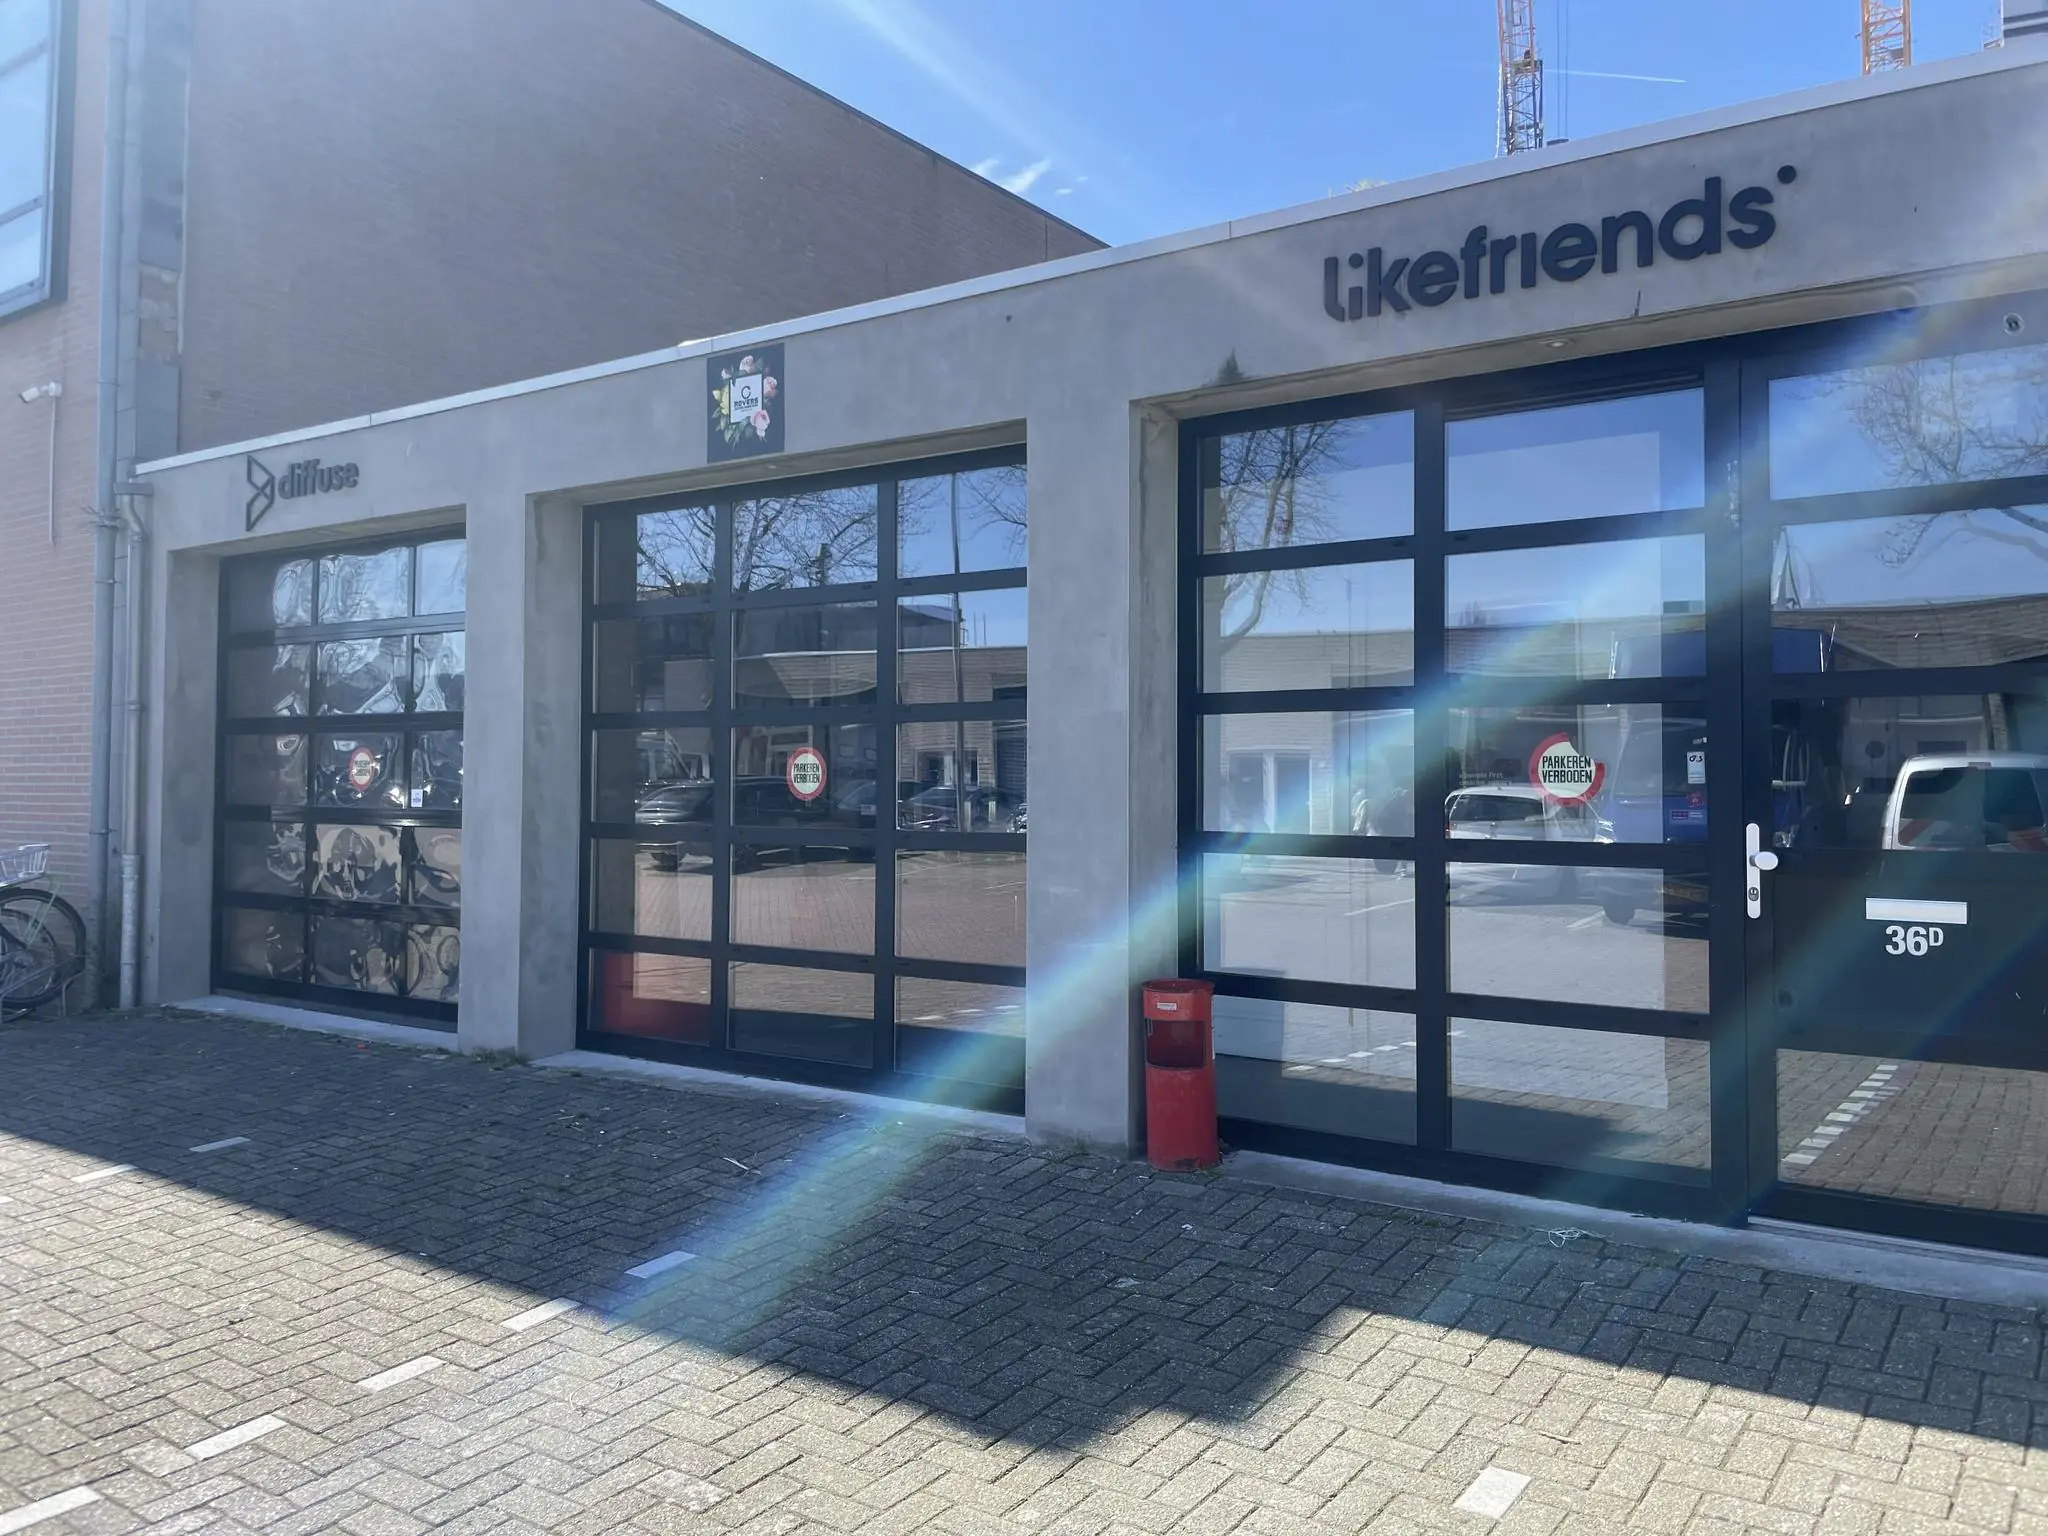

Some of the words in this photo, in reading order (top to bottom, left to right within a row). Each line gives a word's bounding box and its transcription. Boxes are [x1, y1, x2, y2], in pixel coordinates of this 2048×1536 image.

[1324, 164, 1797, 322] likefriends
[734, 397, 759, 407] ROVERS
[278, 458, 359, 499] diffuse
[794, 763, 819, 773] PARKEREN
[1542, 756, 1591, 769] PARKEREN
[1542, 770, 1592, 783] VERBODEN
[1885, 925, 1944, 956] 36D
